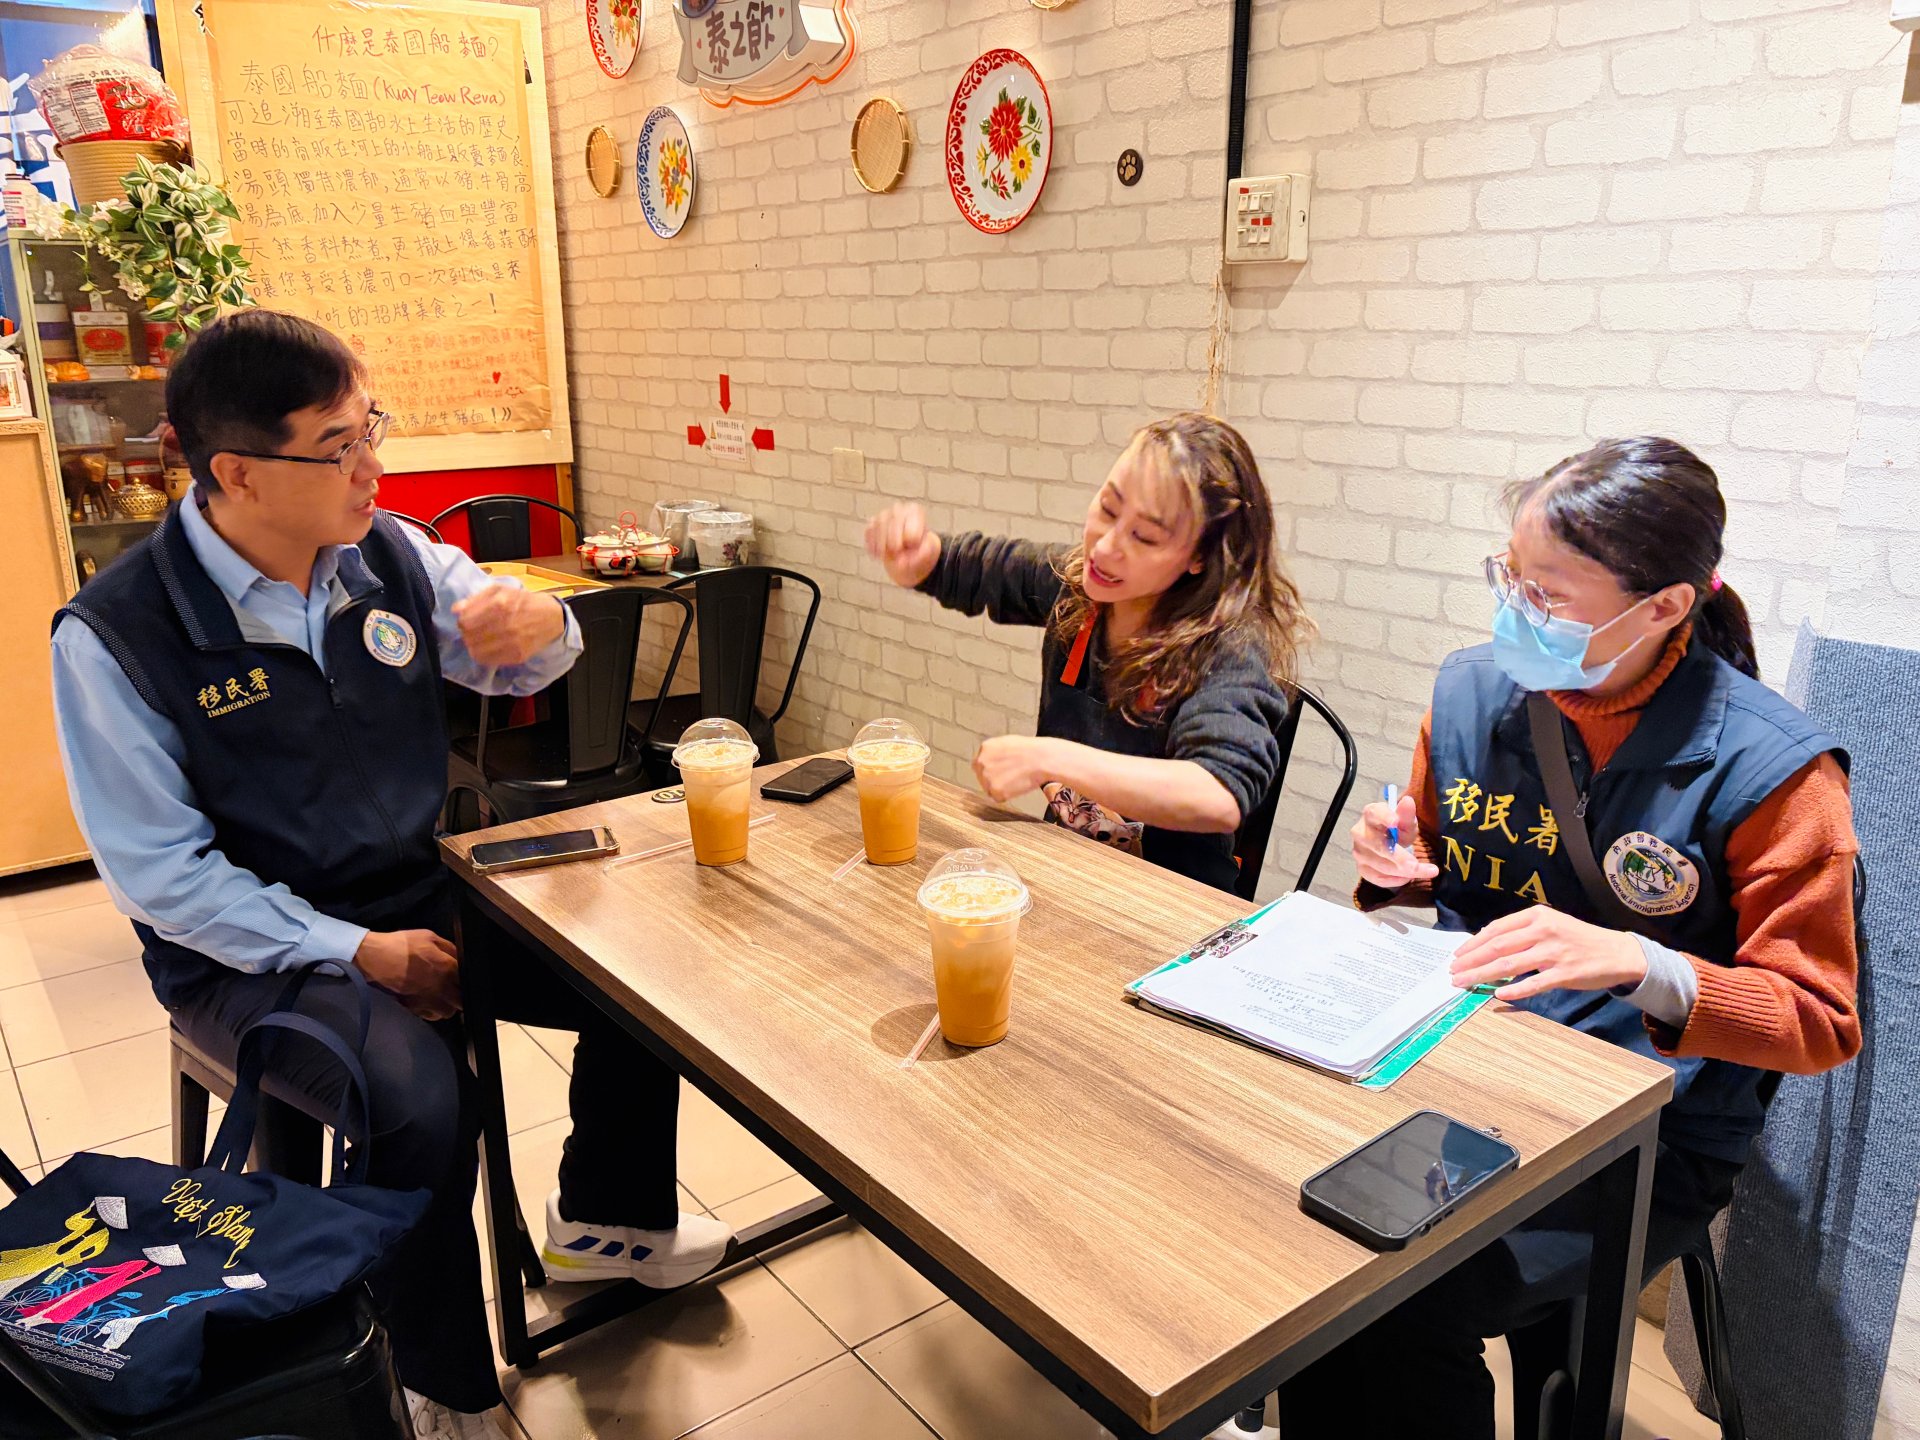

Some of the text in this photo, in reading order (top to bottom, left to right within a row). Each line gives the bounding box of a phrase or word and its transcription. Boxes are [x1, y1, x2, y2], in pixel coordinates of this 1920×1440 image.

[706, 1, 775, 74] 泰之飲
[421, 84, 456, 105] Teow
[196, 667, 270, 709] 移民署
[207, 690, 271, 718] IMMIGRATION
[1442, 777, 1560, 856] 移民署
[1441, 835, 1552, 906] NIA
